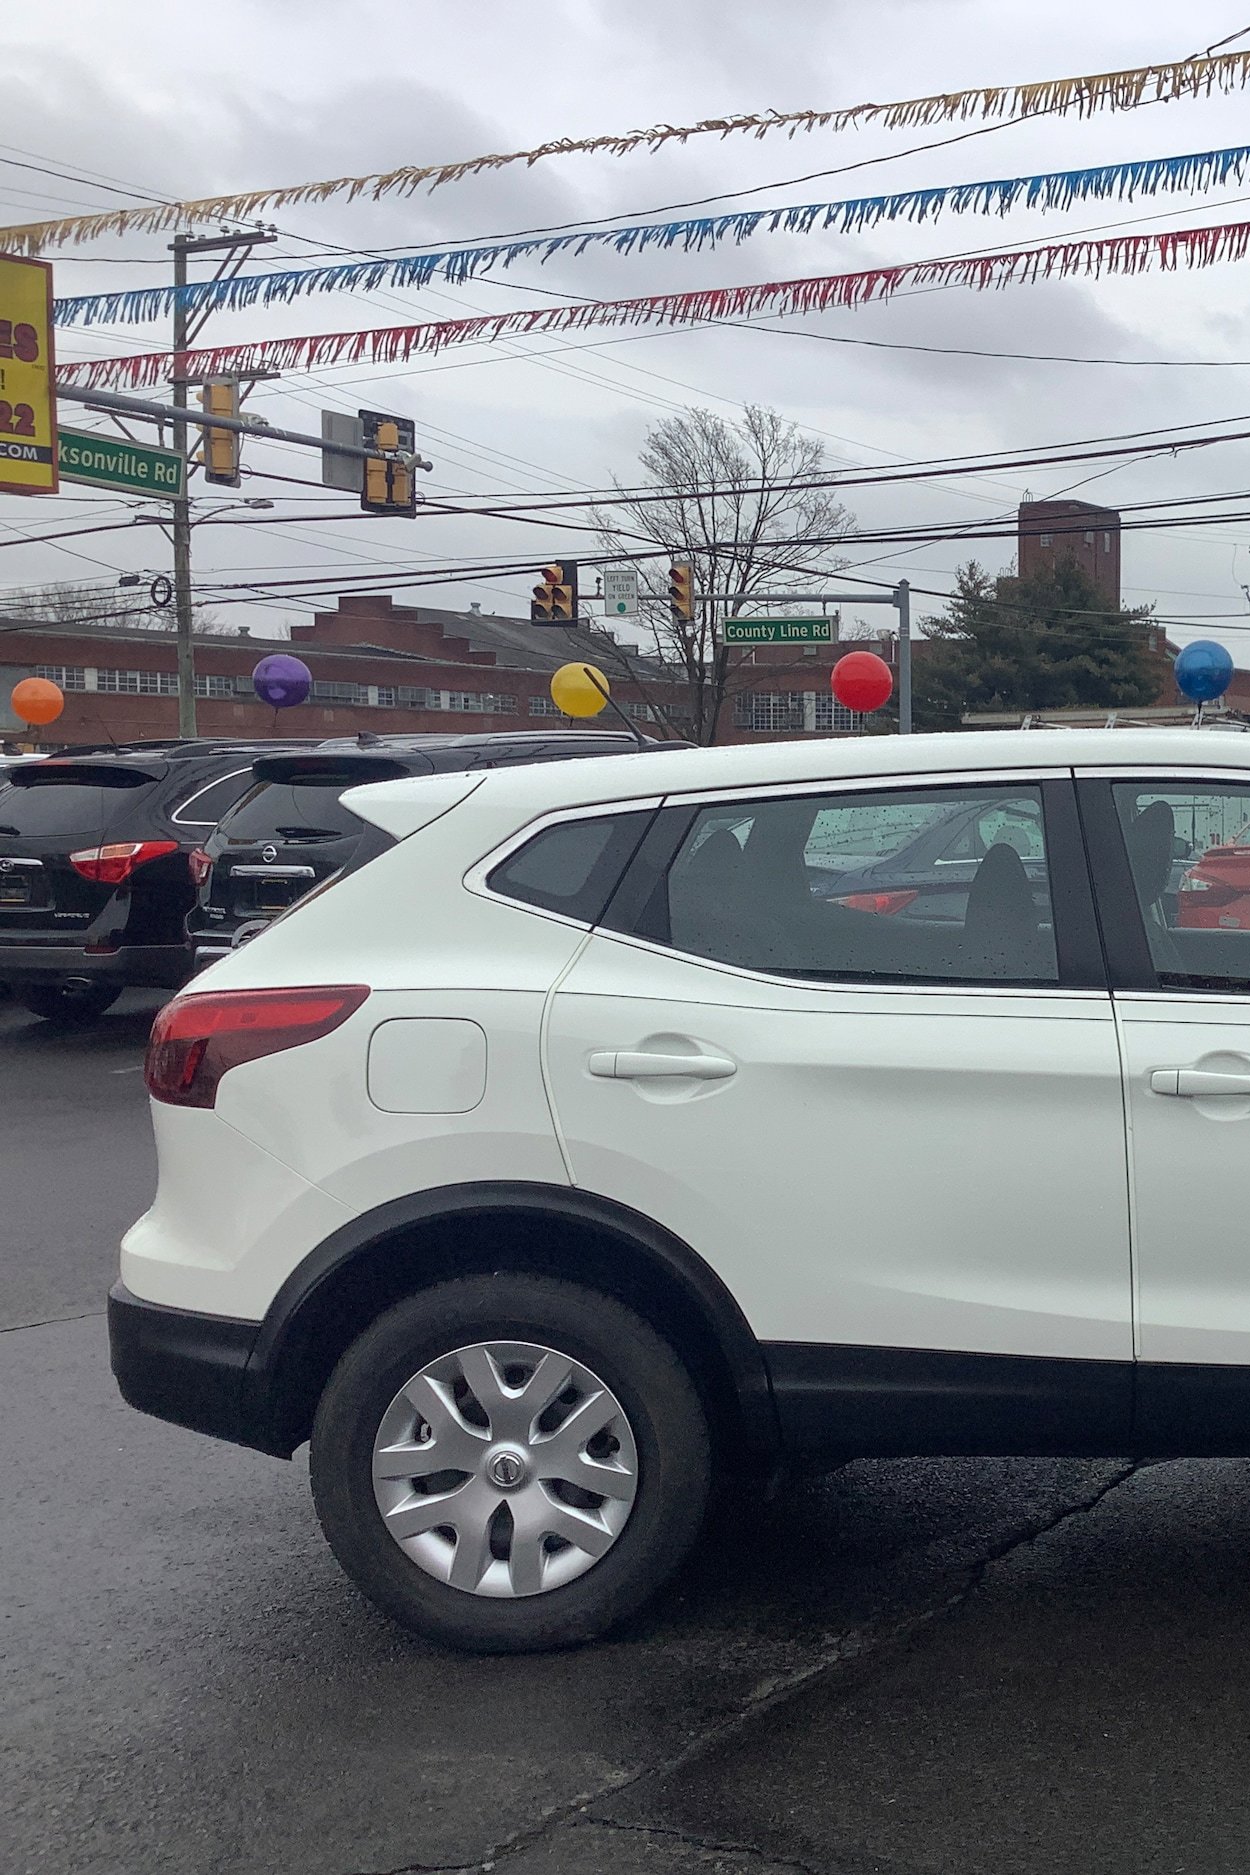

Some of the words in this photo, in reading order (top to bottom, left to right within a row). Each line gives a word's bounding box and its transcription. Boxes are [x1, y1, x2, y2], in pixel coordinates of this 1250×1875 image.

[154, 462, 177, 484] Rd
[612, 583, 631, 592] YIELD
[727, 624, 775, 640] County
[780, 624, 808, 638] Line
[812, 624, 829, 637] Rd
